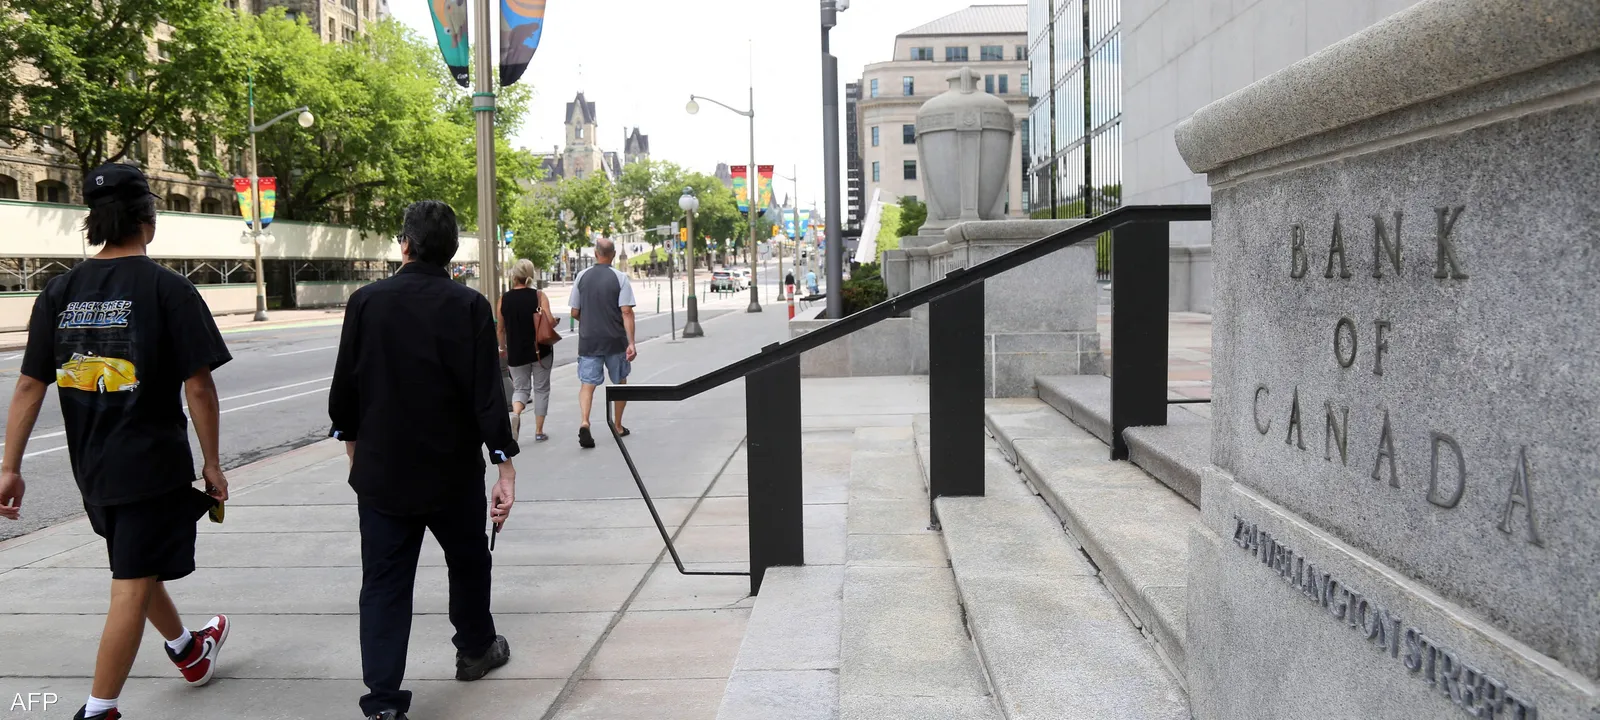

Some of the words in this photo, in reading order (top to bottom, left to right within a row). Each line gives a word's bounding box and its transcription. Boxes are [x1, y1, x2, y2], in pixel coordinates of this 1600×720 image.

[1290, 204, 1470, 280] BANK
[67, 301, 103, 311] BLACK
[1333, 316, 1392, 376] OF
[1253, 384, 1545, 548] CANADA
[1257, 530, 1401, 659] WELLINGTON
[1404, 626, 1538, 720] STREET
